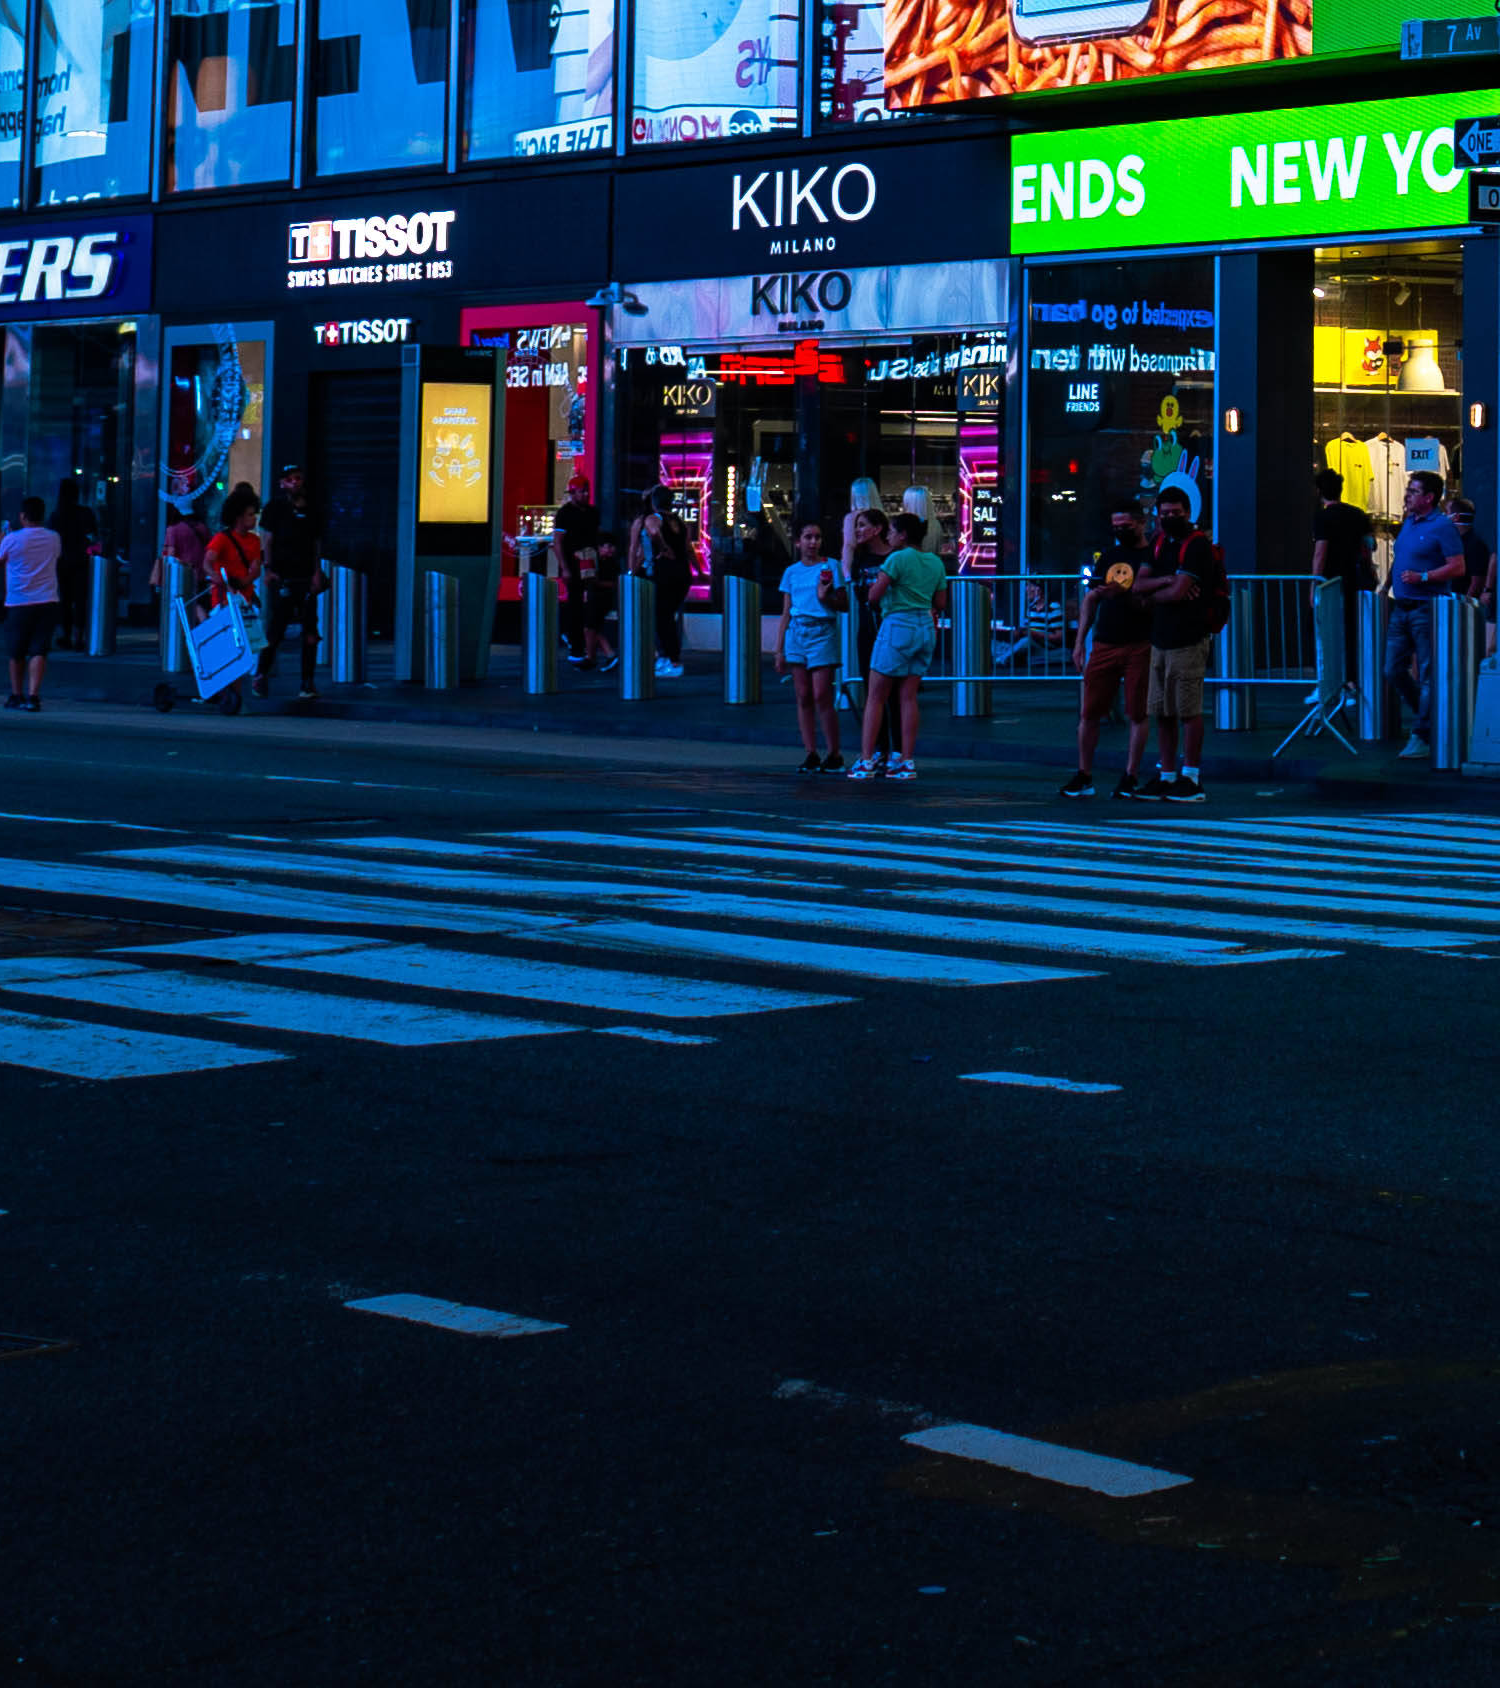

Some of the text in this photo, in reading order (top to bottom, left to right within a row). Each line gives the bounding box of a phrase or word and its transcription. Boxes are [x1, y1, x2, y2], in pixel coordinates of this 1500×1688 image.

[1447, 24, 1482, 52] 7 Av
[1468, 132, 1493, 152] ONE
[1012, 156, 1146, 223] ENDS
[1230, 135, 1367, 207] NEW
[731, 163, 876, 229] KIKO
[332, 210, 455, 260] TISSOT
[770, 237, 836, 255] MILANO
[287, 260, 453, 288] SWISS WATCHES SINCE 1853
[751, 271, 852, 315] KIKO
[340, 318, 411, 345] TISSOT
[663, 384, 712, 406] KIKO
[963, 373, 999, 397] KIK
[1069, 383, 1098, 400] LINE
[1065, 401, 1099, 412] FRIENDS
[1411, 449, 1430, 460] EXIT
[973, 506, 996, 522] SAL
